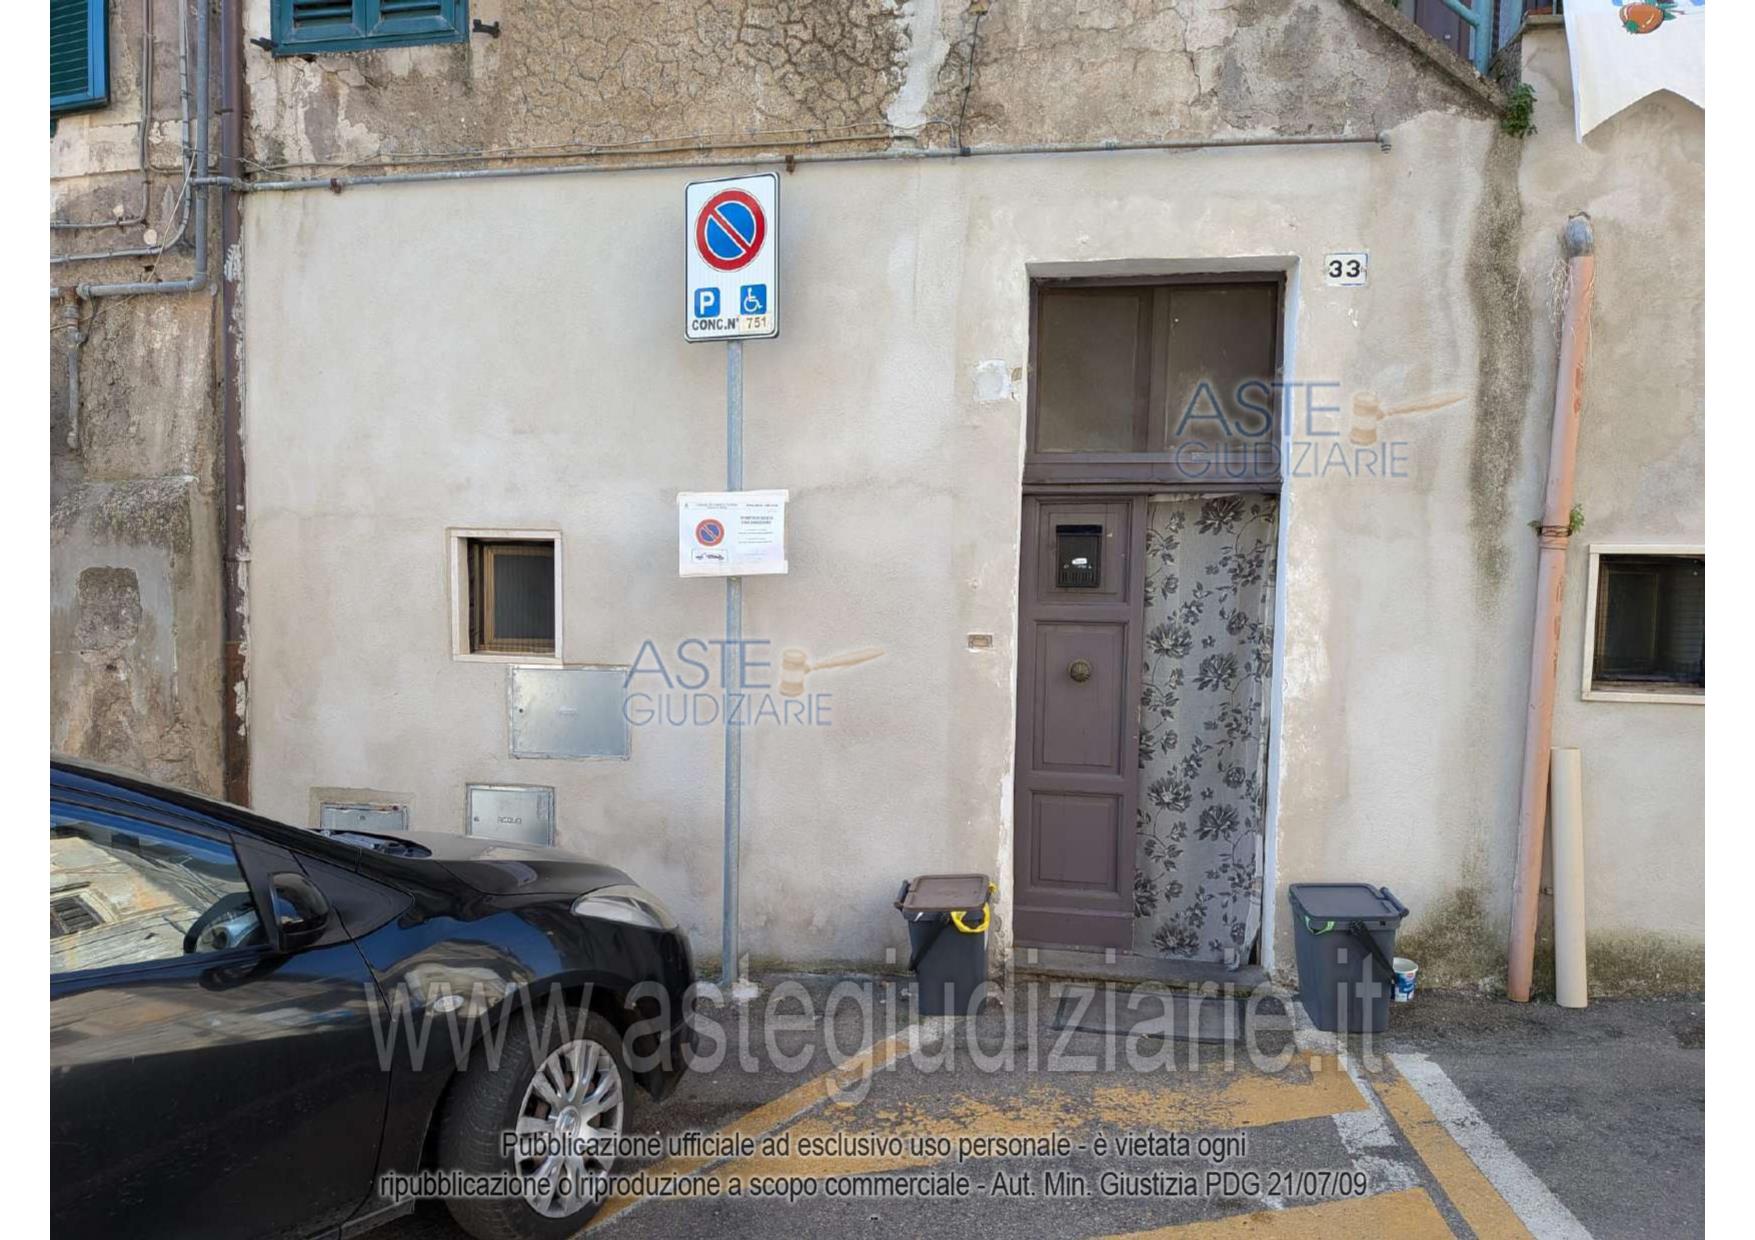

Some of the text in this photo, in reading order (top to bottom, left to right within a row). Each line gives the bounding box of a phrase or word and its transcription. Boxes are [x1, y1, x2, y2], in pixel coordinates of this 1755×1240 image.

[1328, 259, 1360, 278] 33
[700, 291, 715, 315] P
[746, 317, 767, 328] 751
